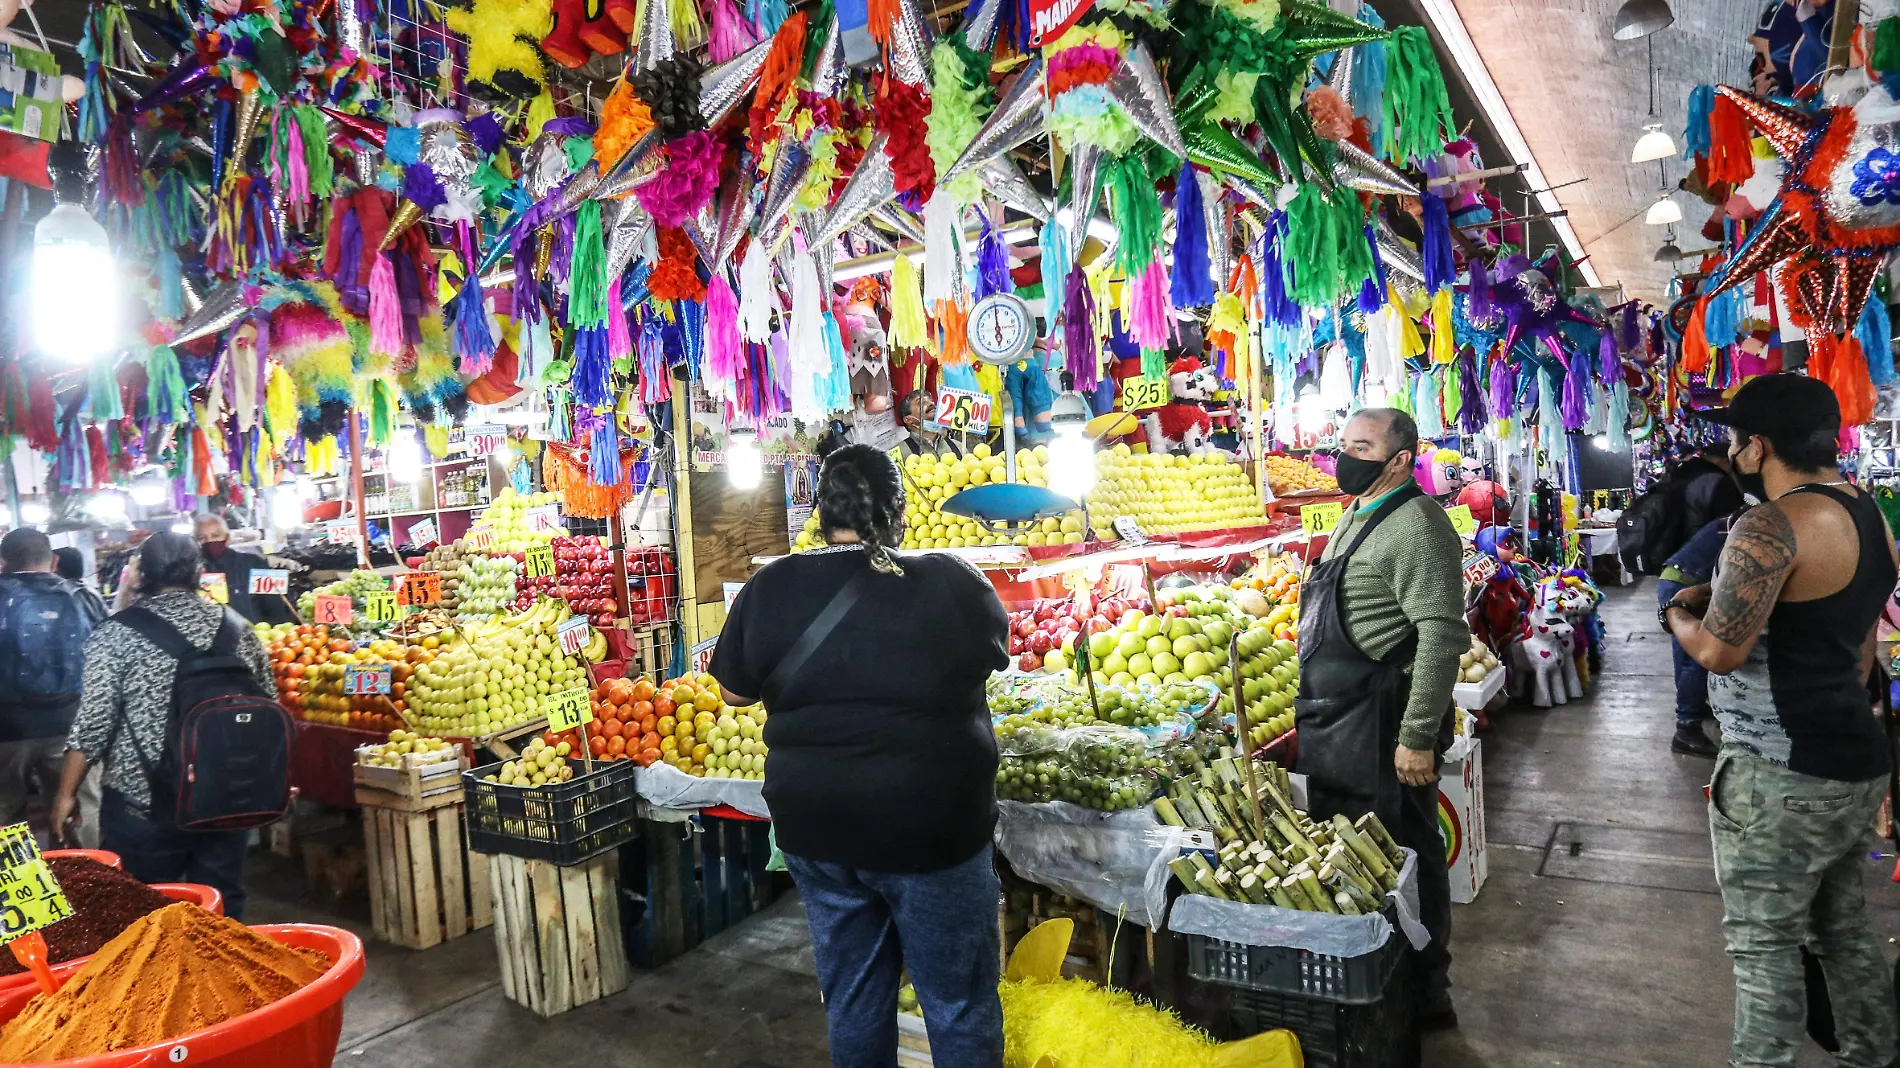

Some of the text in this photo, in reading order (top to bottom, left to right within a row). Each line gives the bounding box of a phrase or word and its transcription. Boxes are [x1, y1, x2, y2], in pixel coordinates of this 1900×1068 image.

[1312, 512, 1324, 531] 8
[531, 553, 549, 578] 15
[255, 576, 273, 593] 10
[406, 580, 430, 606] 15
[325, 600, 336, 623] 8
[377, 598, 396, 621] 15
[354, 671, 379, 693] 12
[1727, 673, 1750, 691] CKEY
[557, 699, 580, 726] 13
[174, 1048, 181, 1060] 1
